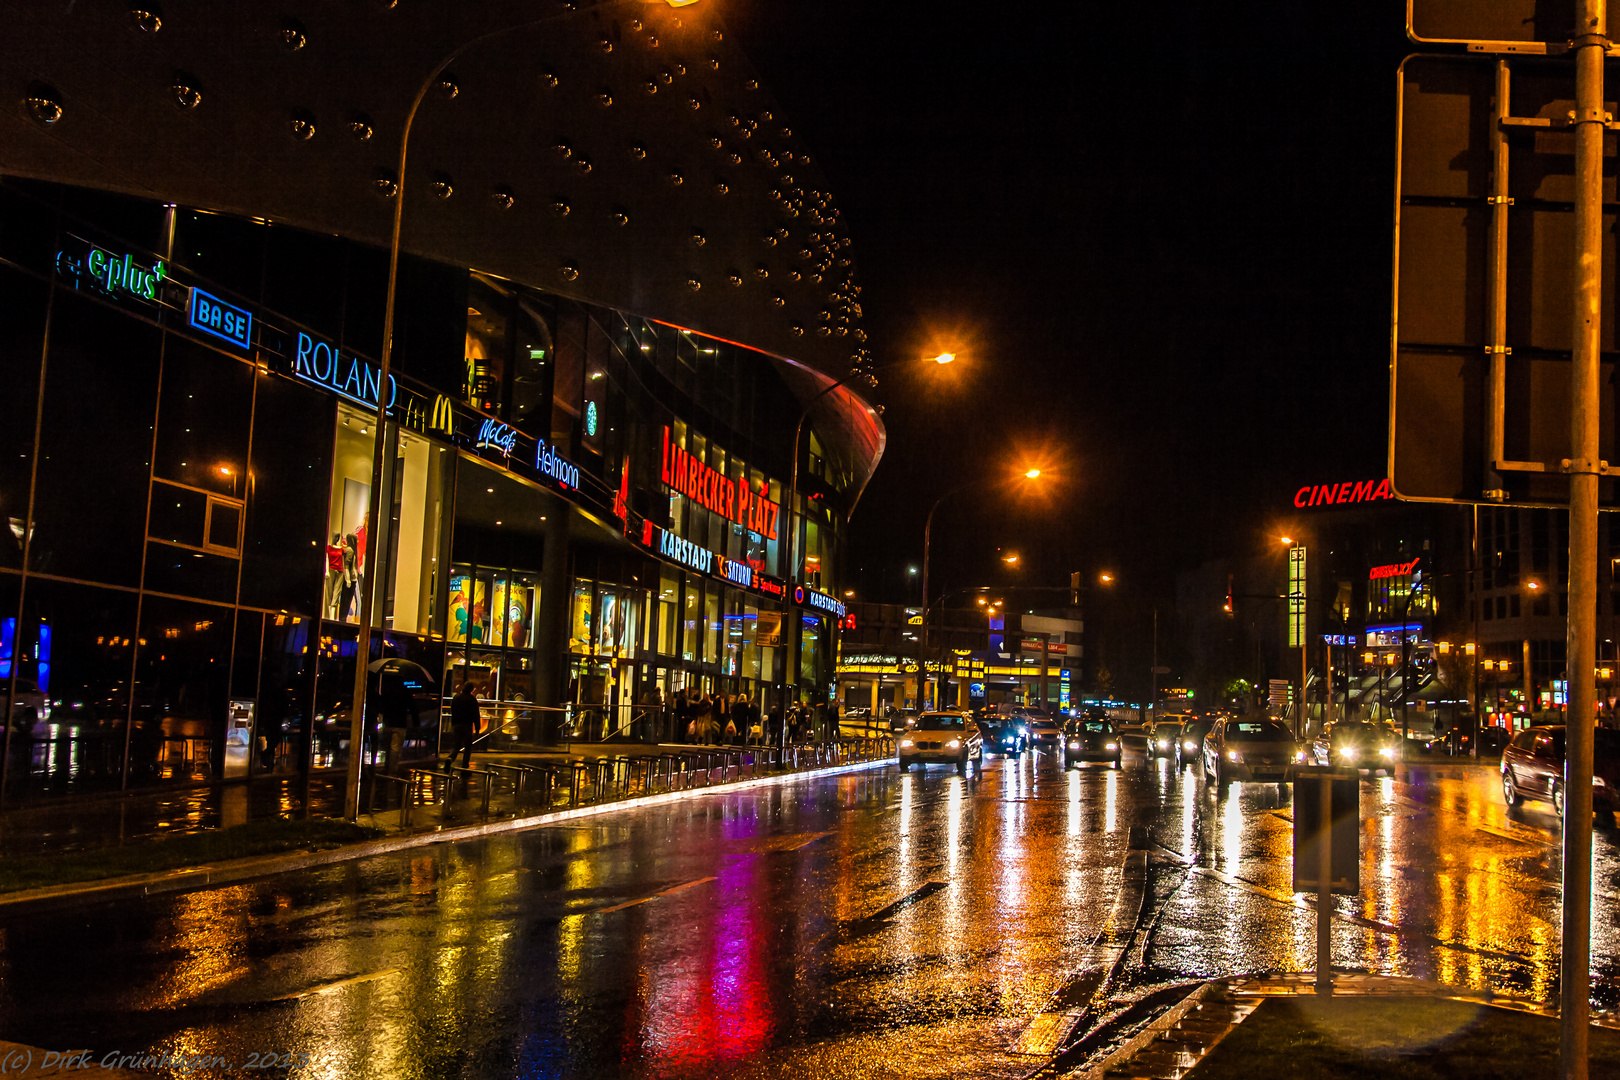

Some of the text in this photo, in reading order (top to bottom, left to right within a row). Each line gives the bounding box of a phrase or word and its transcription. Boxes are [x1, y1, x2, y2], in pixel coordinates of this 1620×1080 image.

[199, 299, 246, 340] BASE
[296, 331, 397, 409] ROLAND
[536, 439, 580, 490] fielmann
[661, 425, 779, 541] LIMBECKER PLATZ
[1294, 478, 1395, 508] CINEMA
[660, 528, 713, 574] KARSTADT
[728, 559, 752, 587] SATURN
[810, 591, 837, 614] KARSTADT
